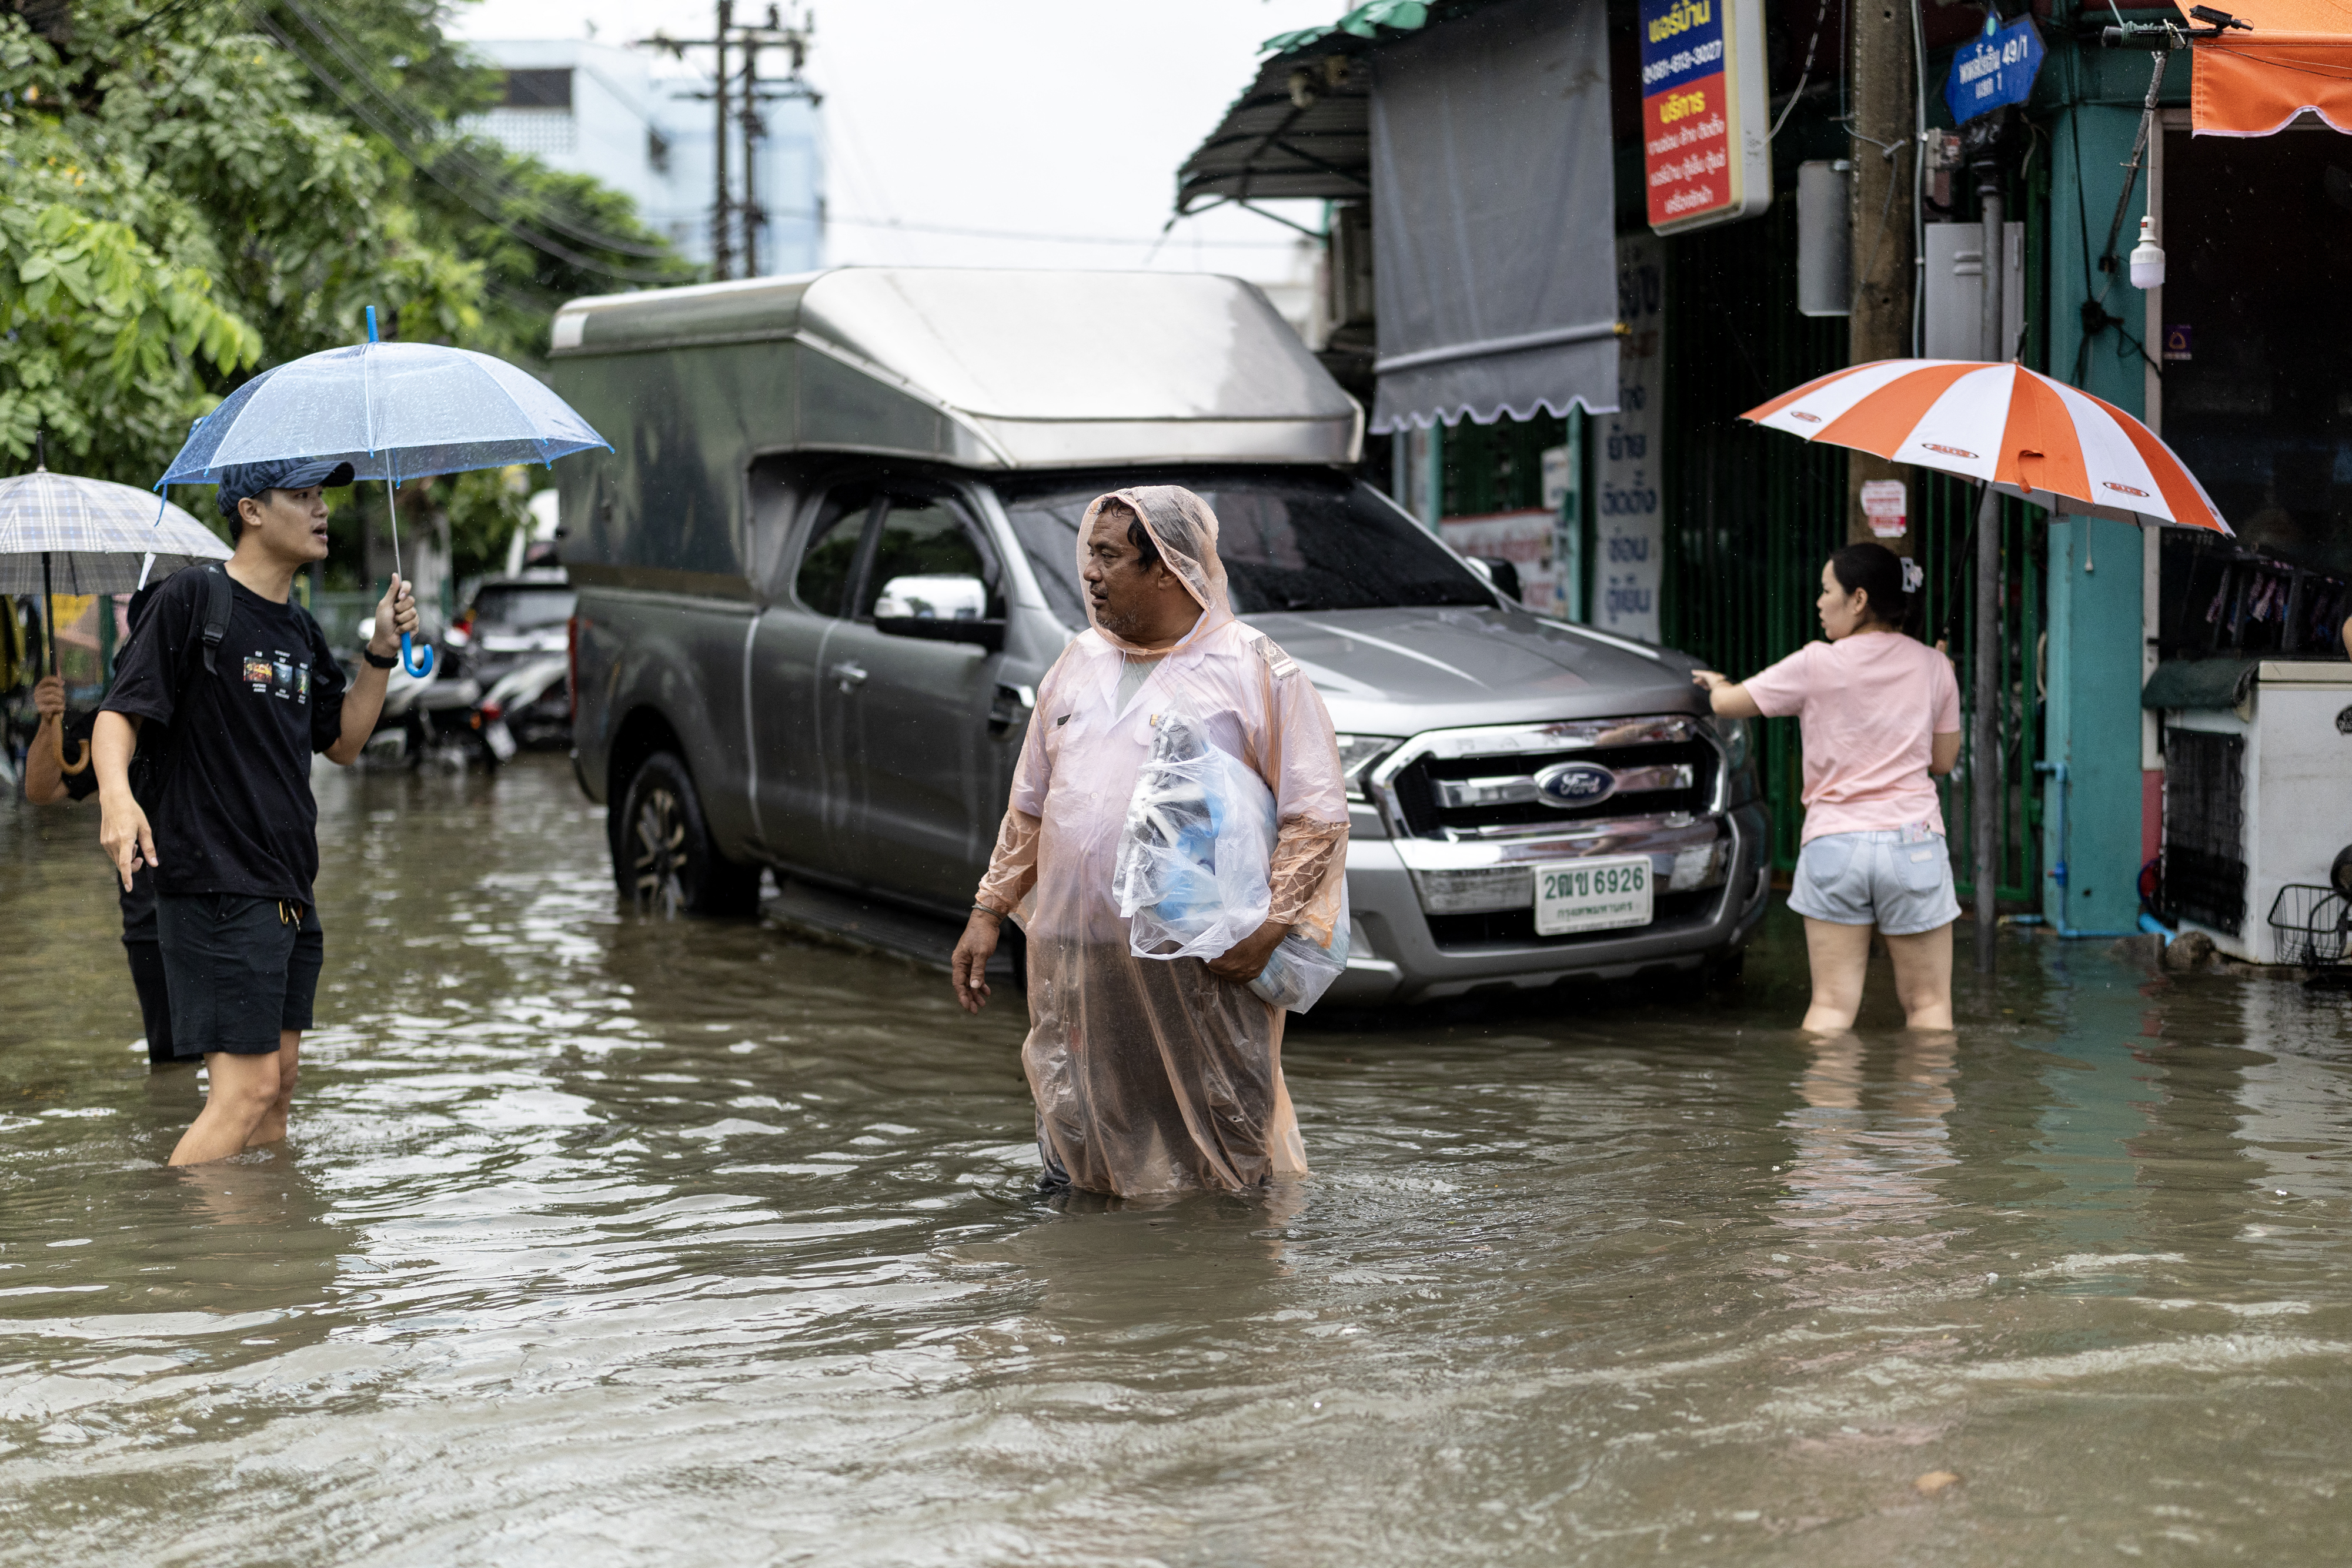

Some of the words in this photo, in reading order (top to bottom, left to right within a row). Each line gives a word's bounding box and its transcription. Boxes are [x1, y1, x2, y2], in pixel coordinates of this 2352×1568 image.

[2002, 34, 2028, 66] 49/1
[1997, 72, 2002, 91] 1
[1659, 91, 1705, 124] บริการ
[1560, 773, 1601, 795] Ford
[1594, 866, 1644, 894] 6926
[1557, 901, 1633, 921] กรุงเทพมหานคร
